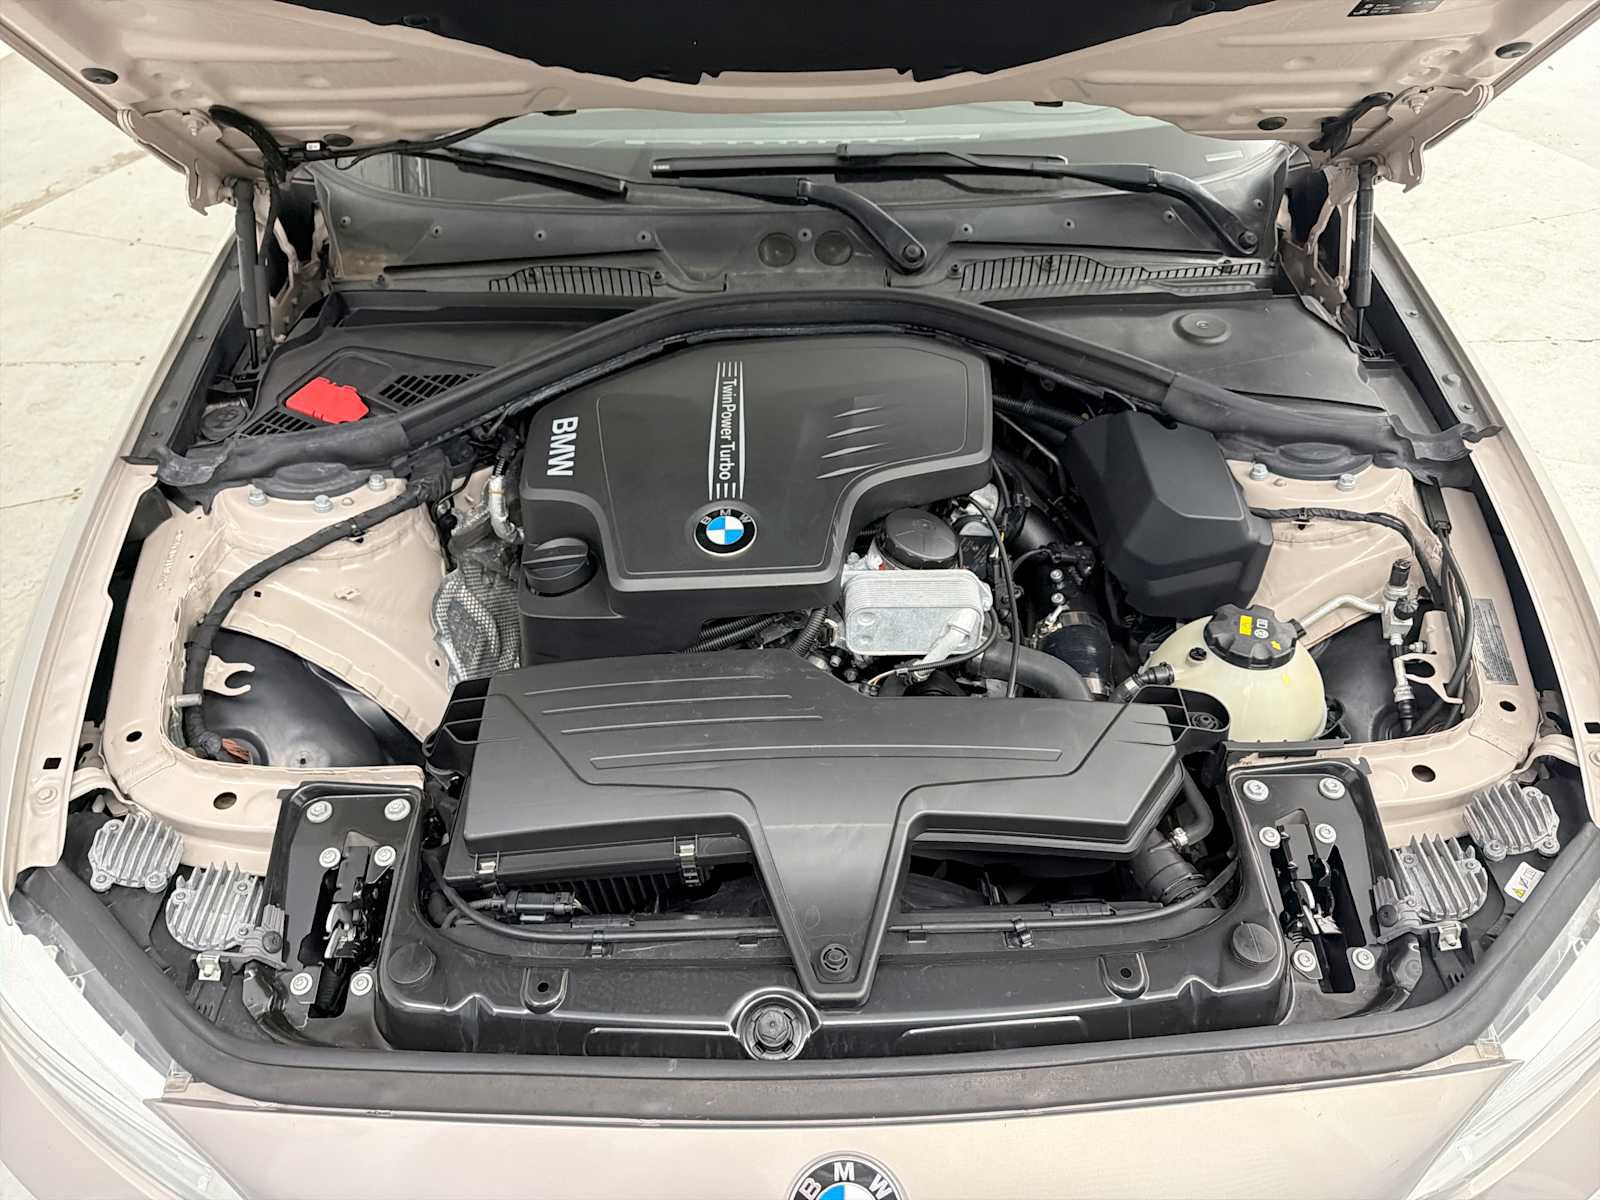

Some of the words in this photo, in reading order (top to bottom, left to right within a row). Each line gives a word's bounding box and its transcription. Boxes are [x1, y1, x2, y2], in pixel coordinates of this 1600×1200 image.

[720, 378, 738, 440] TwinPower
[547, 416, 579, 477] BMW
[718, 441, 736, 481] Turbo
[700, 508, 752, 526] BMW
[799, 1161, 893, 1200] BMW
